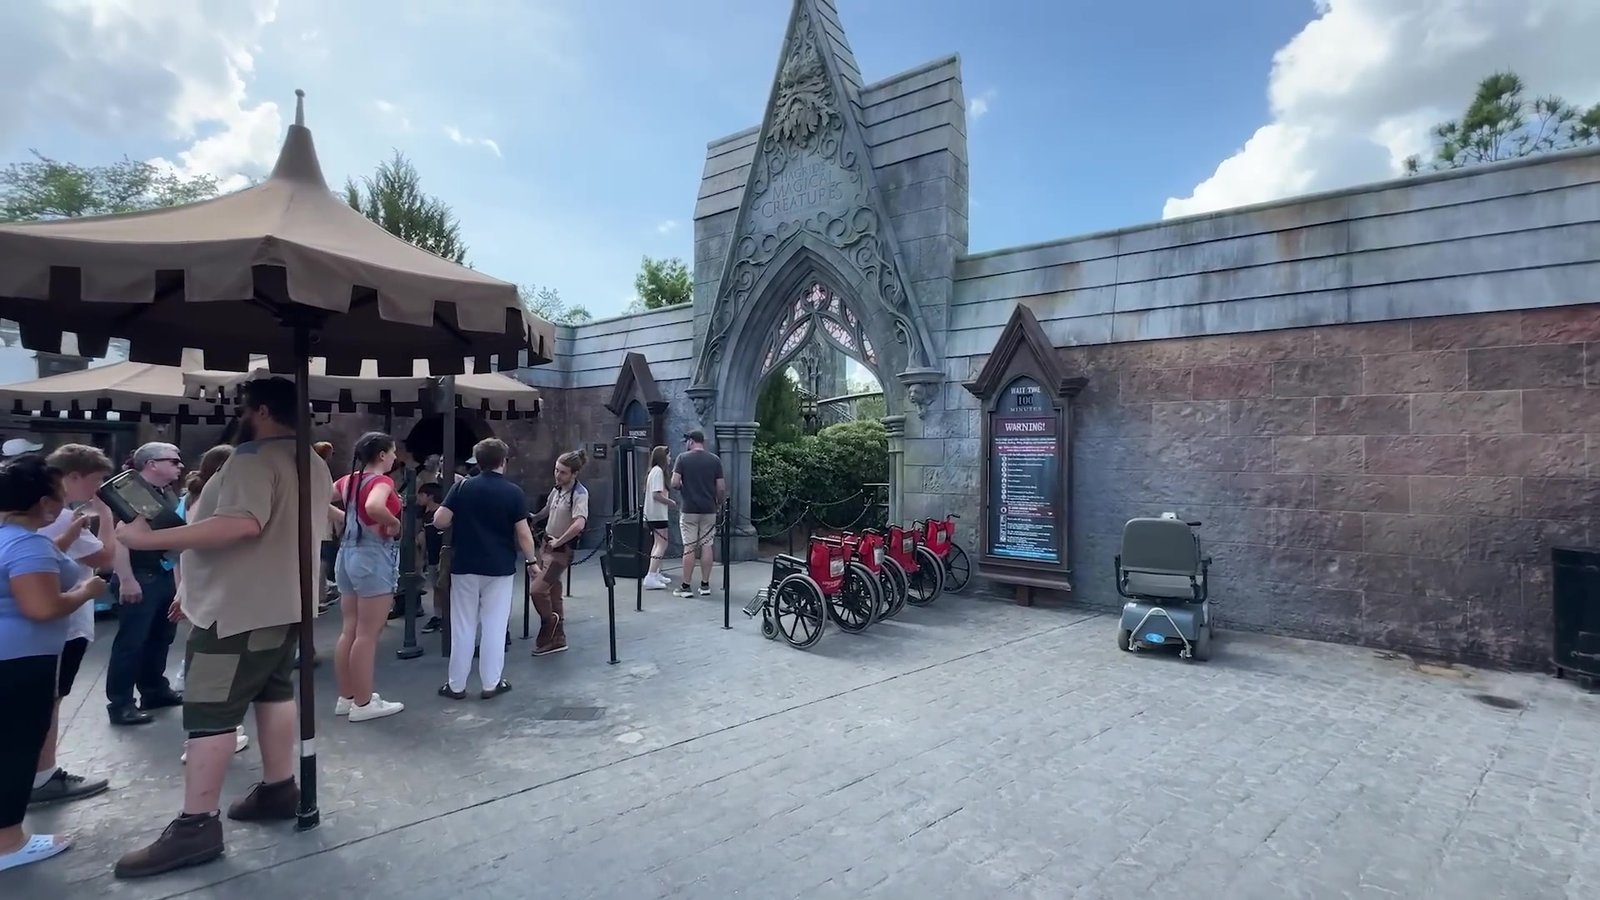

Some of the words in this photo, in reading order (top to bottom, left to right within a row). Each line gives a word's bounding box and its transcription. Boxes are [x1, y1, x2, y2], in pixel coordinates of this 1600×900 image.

[773, 170, 834, 200] MAGICAL
[762, 181, 843, 218] CREATURES
[1010, 387, 1026, 395] WAIT
[1018, 396, 1034, 405] 100
[1004, 422, 1046, 432] WARNING!
